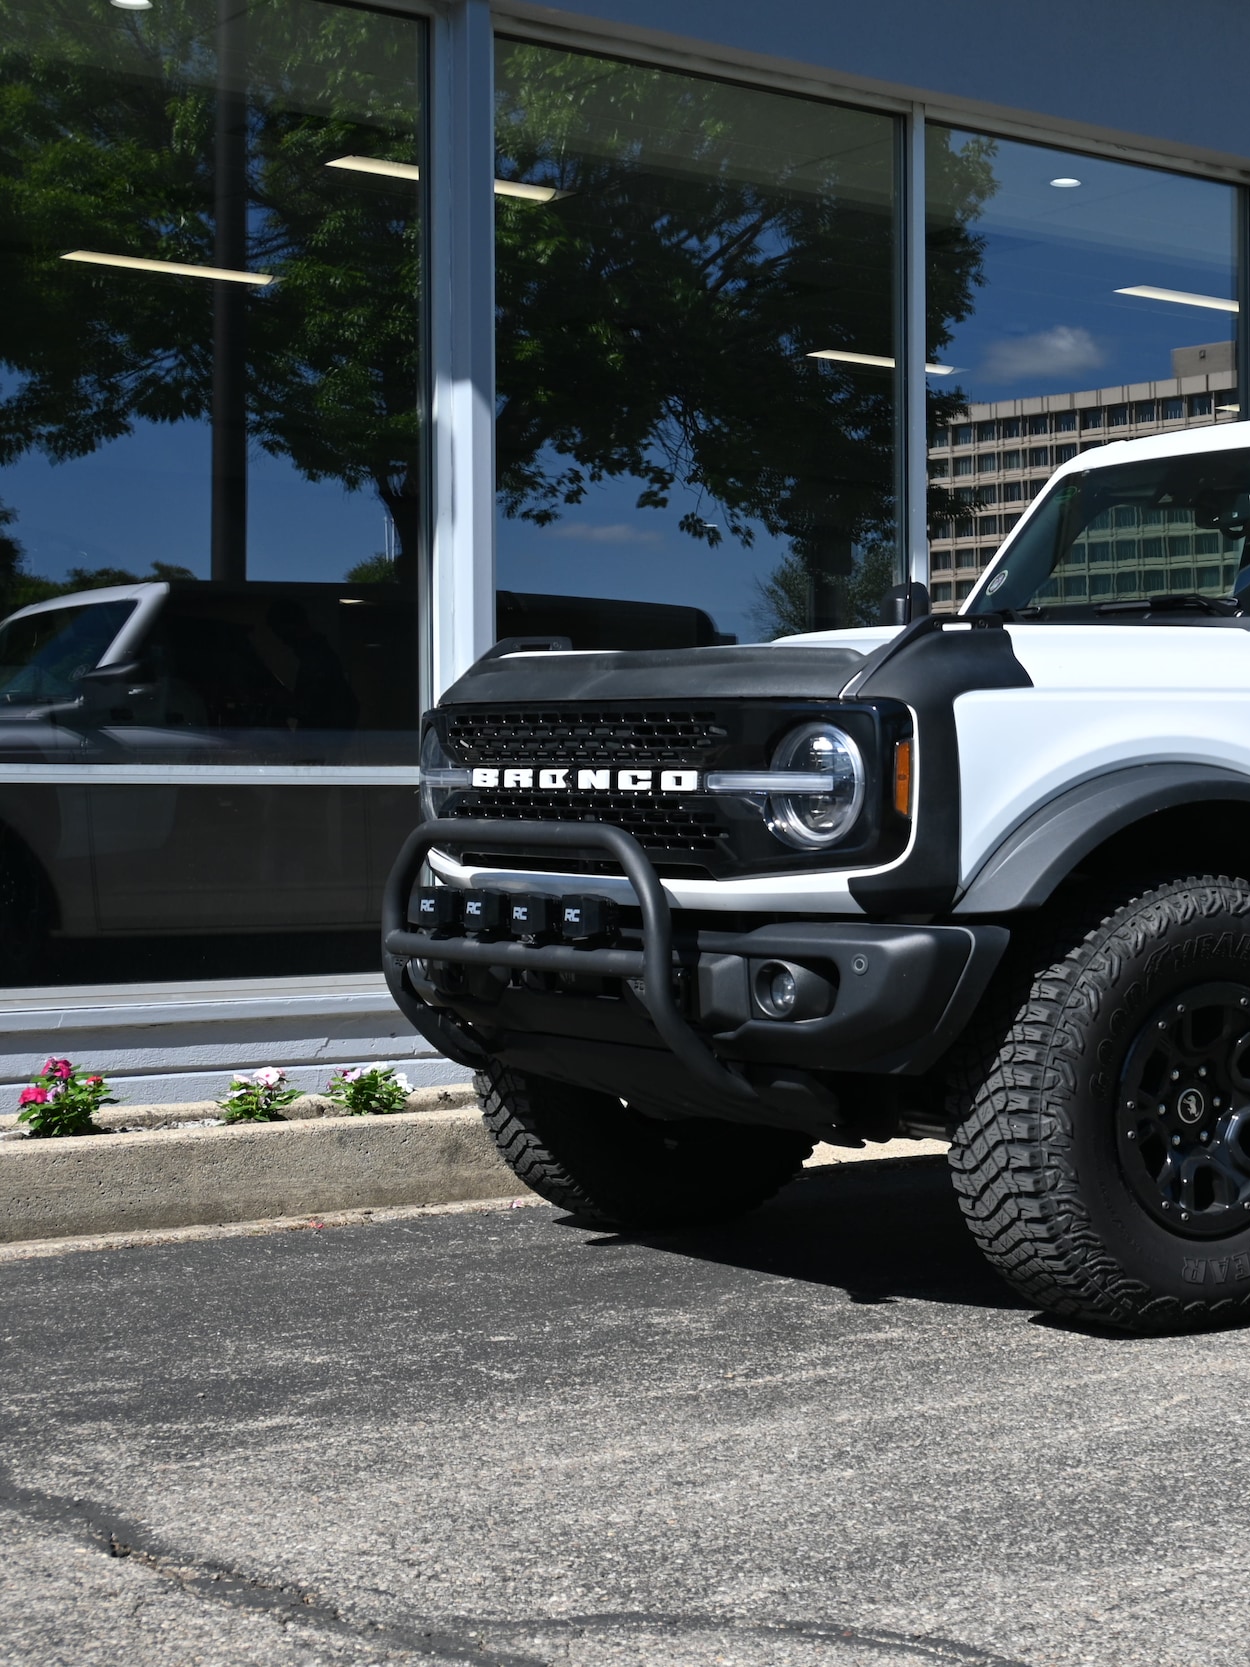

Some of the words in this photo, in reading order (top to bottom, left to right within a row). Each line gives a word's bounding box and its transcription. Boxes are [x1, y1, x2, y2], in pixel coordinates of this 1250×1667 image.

[472, 767, 698, 792] BRONCO
[420, 899, 436, 913] RC
[466, 901, 482, 915] RC
[513, 907, 528, 921] RC
[564, 908, 580, 922] RC
